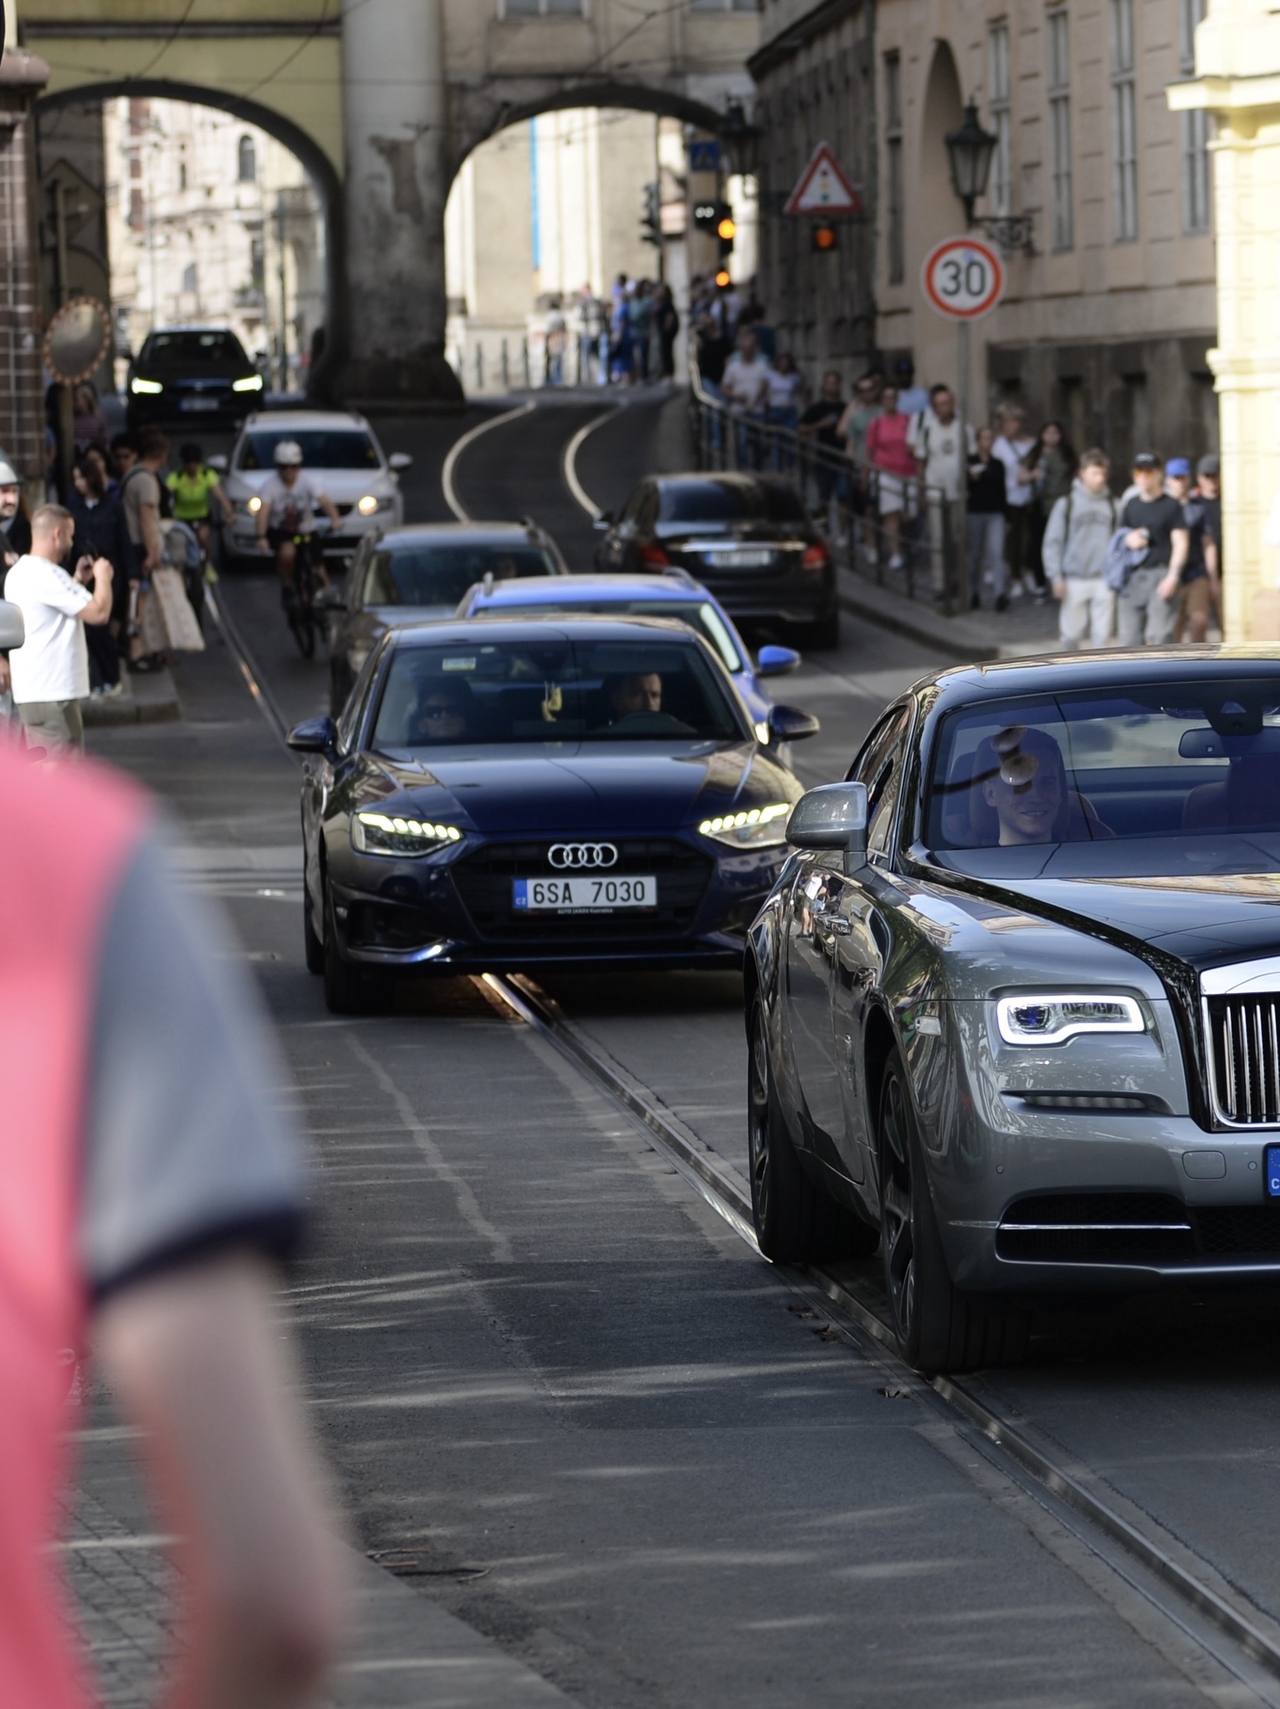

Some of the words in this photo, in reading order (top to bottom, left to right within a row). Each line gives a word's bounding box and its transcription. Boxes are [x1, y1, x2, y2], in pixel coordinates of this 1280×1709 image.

[941, 259, 986, 297] 30
[515, 897, 526, 905] CZ
[533, 882, 573, 905] 6SA
[591, 880, 645, 903] 7030
